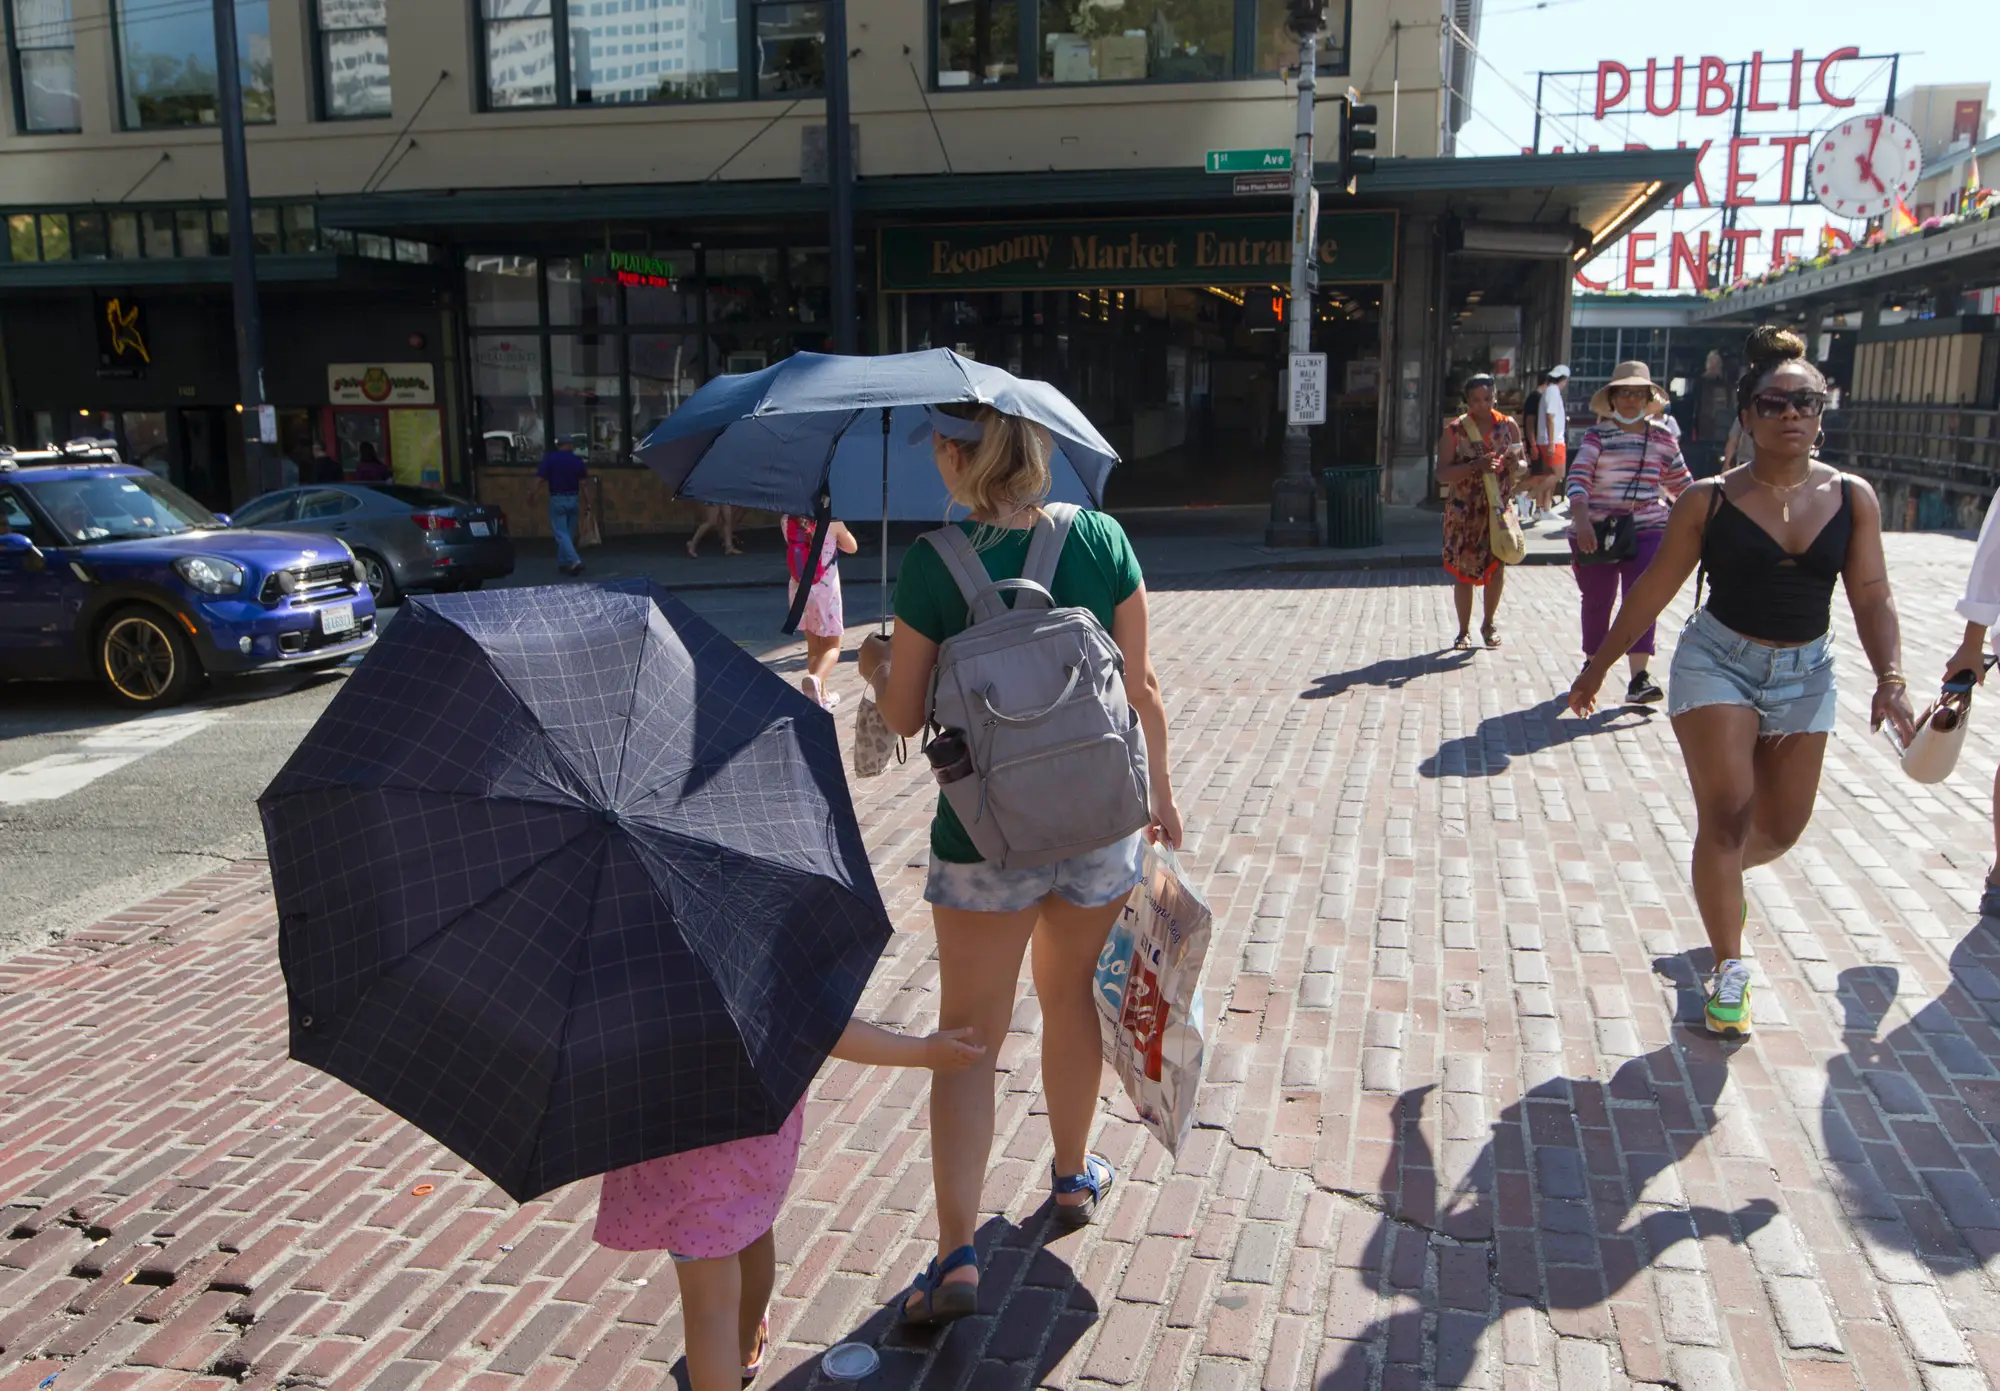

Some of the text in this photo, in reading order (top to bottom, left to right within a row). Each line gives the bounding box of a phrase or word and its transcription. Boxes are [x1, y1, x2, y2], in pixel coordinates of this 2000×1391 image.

[1594, 46, 1860, 120] PUBLIC
[1213, 153, 1285, 170] 1st Ave
[1267, 182, 1289, 191] Market
[932, 231, 1338, 275] Economy Market Entrae
[1272, 296, 1283, 322] 4
[1295, 358, 1322, 368] ALL WAY
[1300, 370, 1316, 378] WALK
